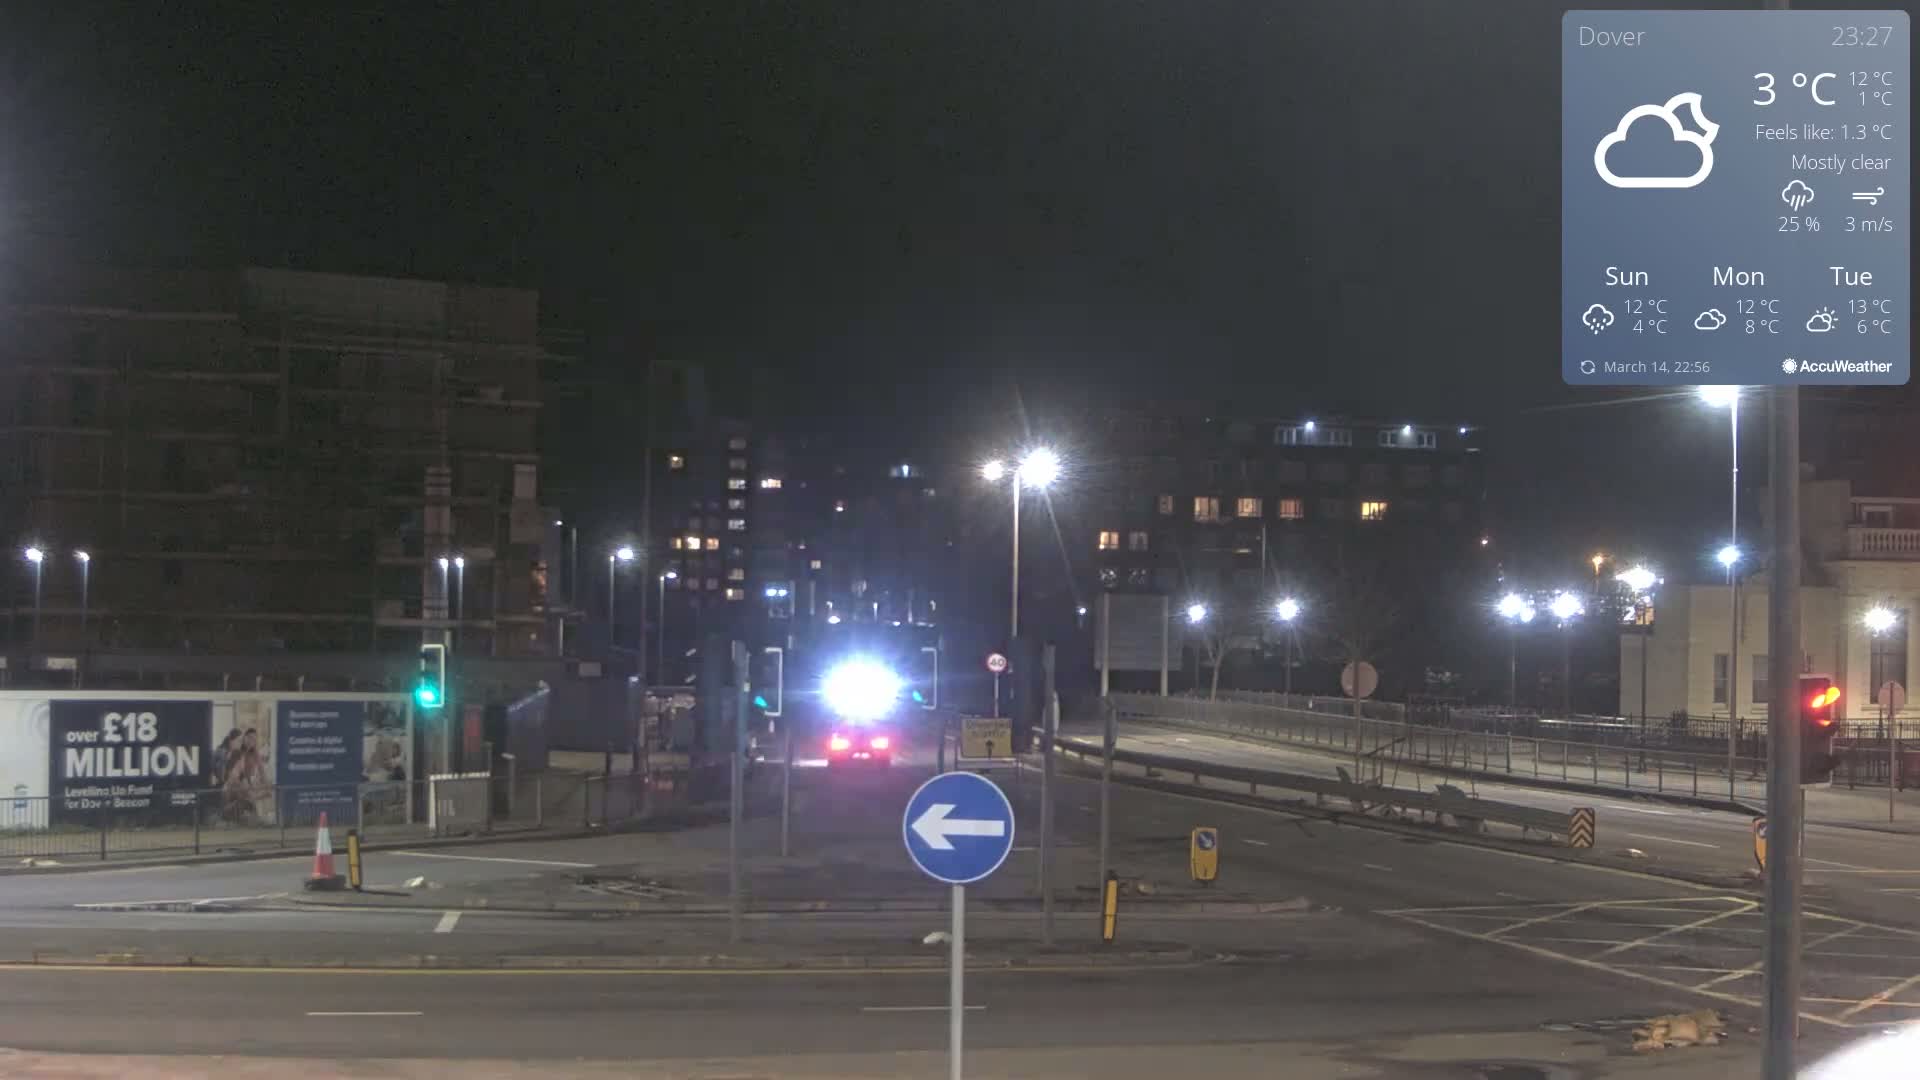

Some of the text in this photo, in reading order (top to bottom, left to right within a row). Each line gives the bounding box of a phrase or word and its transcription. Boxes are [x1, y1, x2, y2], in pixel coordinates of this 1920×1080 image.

[990, 658, 1005, 667] 40
[66, 711, 158, 742] over £18
[66, 745, 200, 777] MILLION
